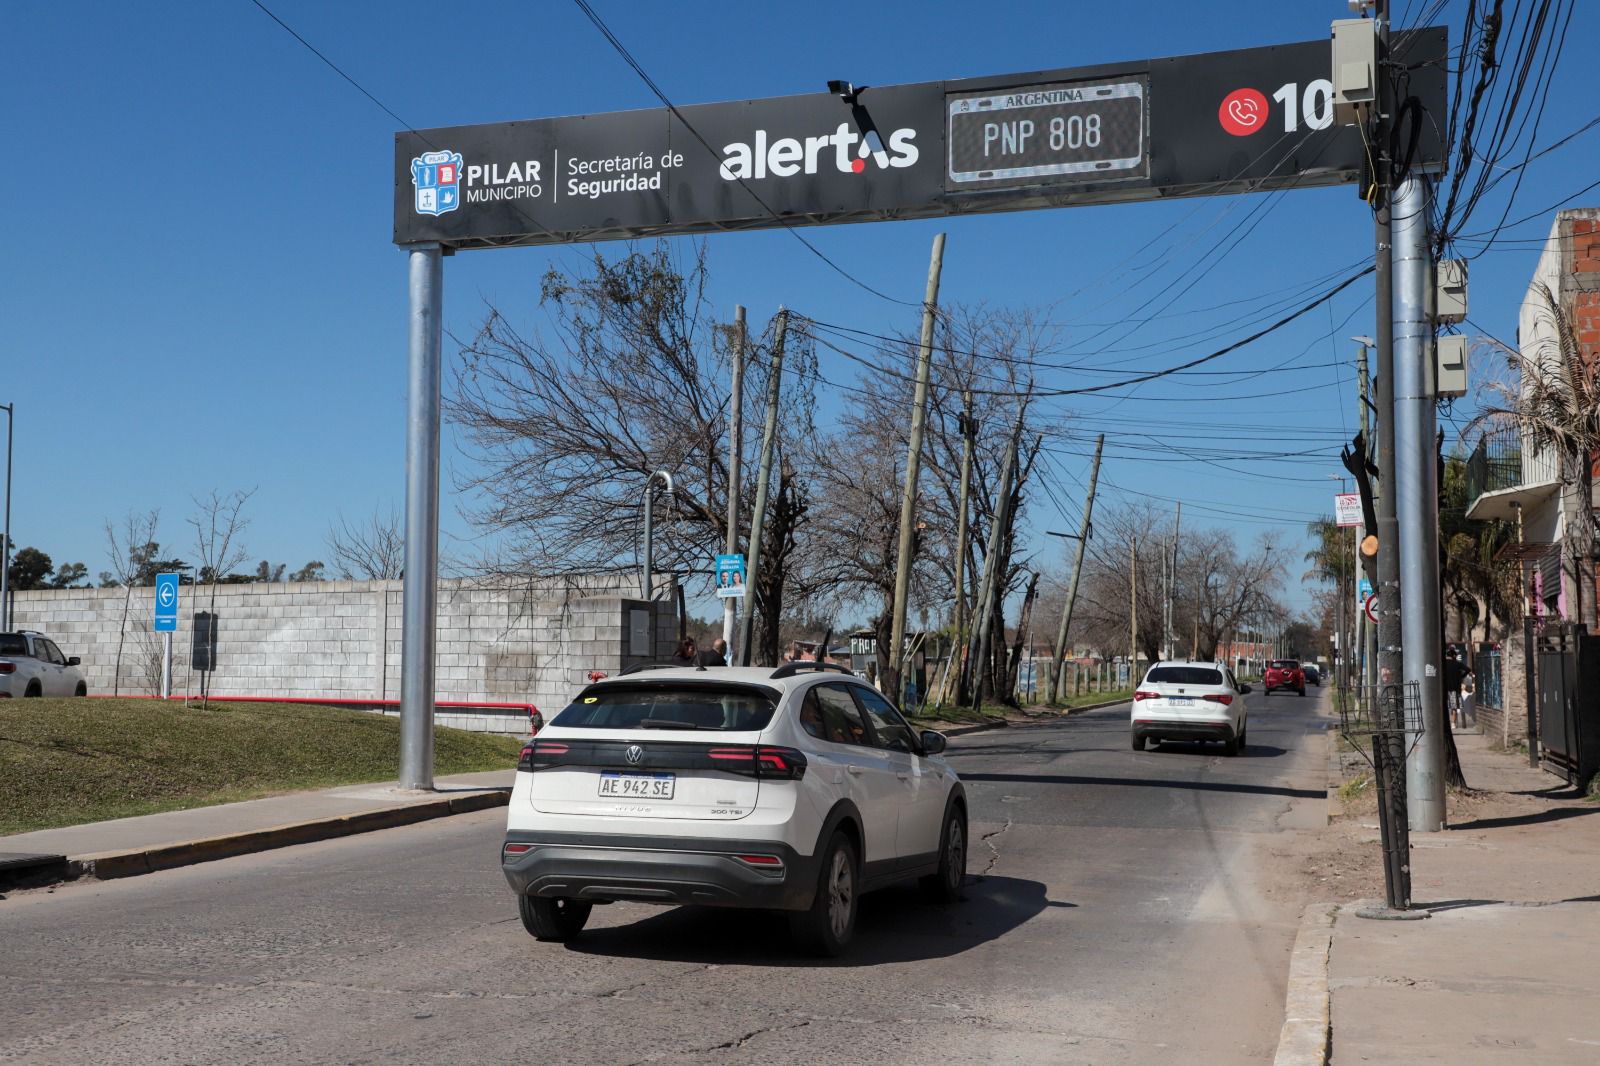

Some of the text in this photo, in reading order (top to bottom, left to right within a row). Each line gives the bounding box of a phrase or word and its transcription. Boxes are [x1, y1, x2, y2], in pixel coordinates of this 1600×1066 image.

[1006, 89, 1083, 108] ARGENTINA
[984, 113, 1101, 157] PNP 808
[428, 155, 445, 164] PILAR
[568, 149, 684, 175] Secretaría de
[467, 160, 541, 187] PILAR
[466, 184, 542, 203] MUNICIPIO
[567, 171, 661, 199] Seguridad
[602, 779, 670, 796] AE 942 SE
